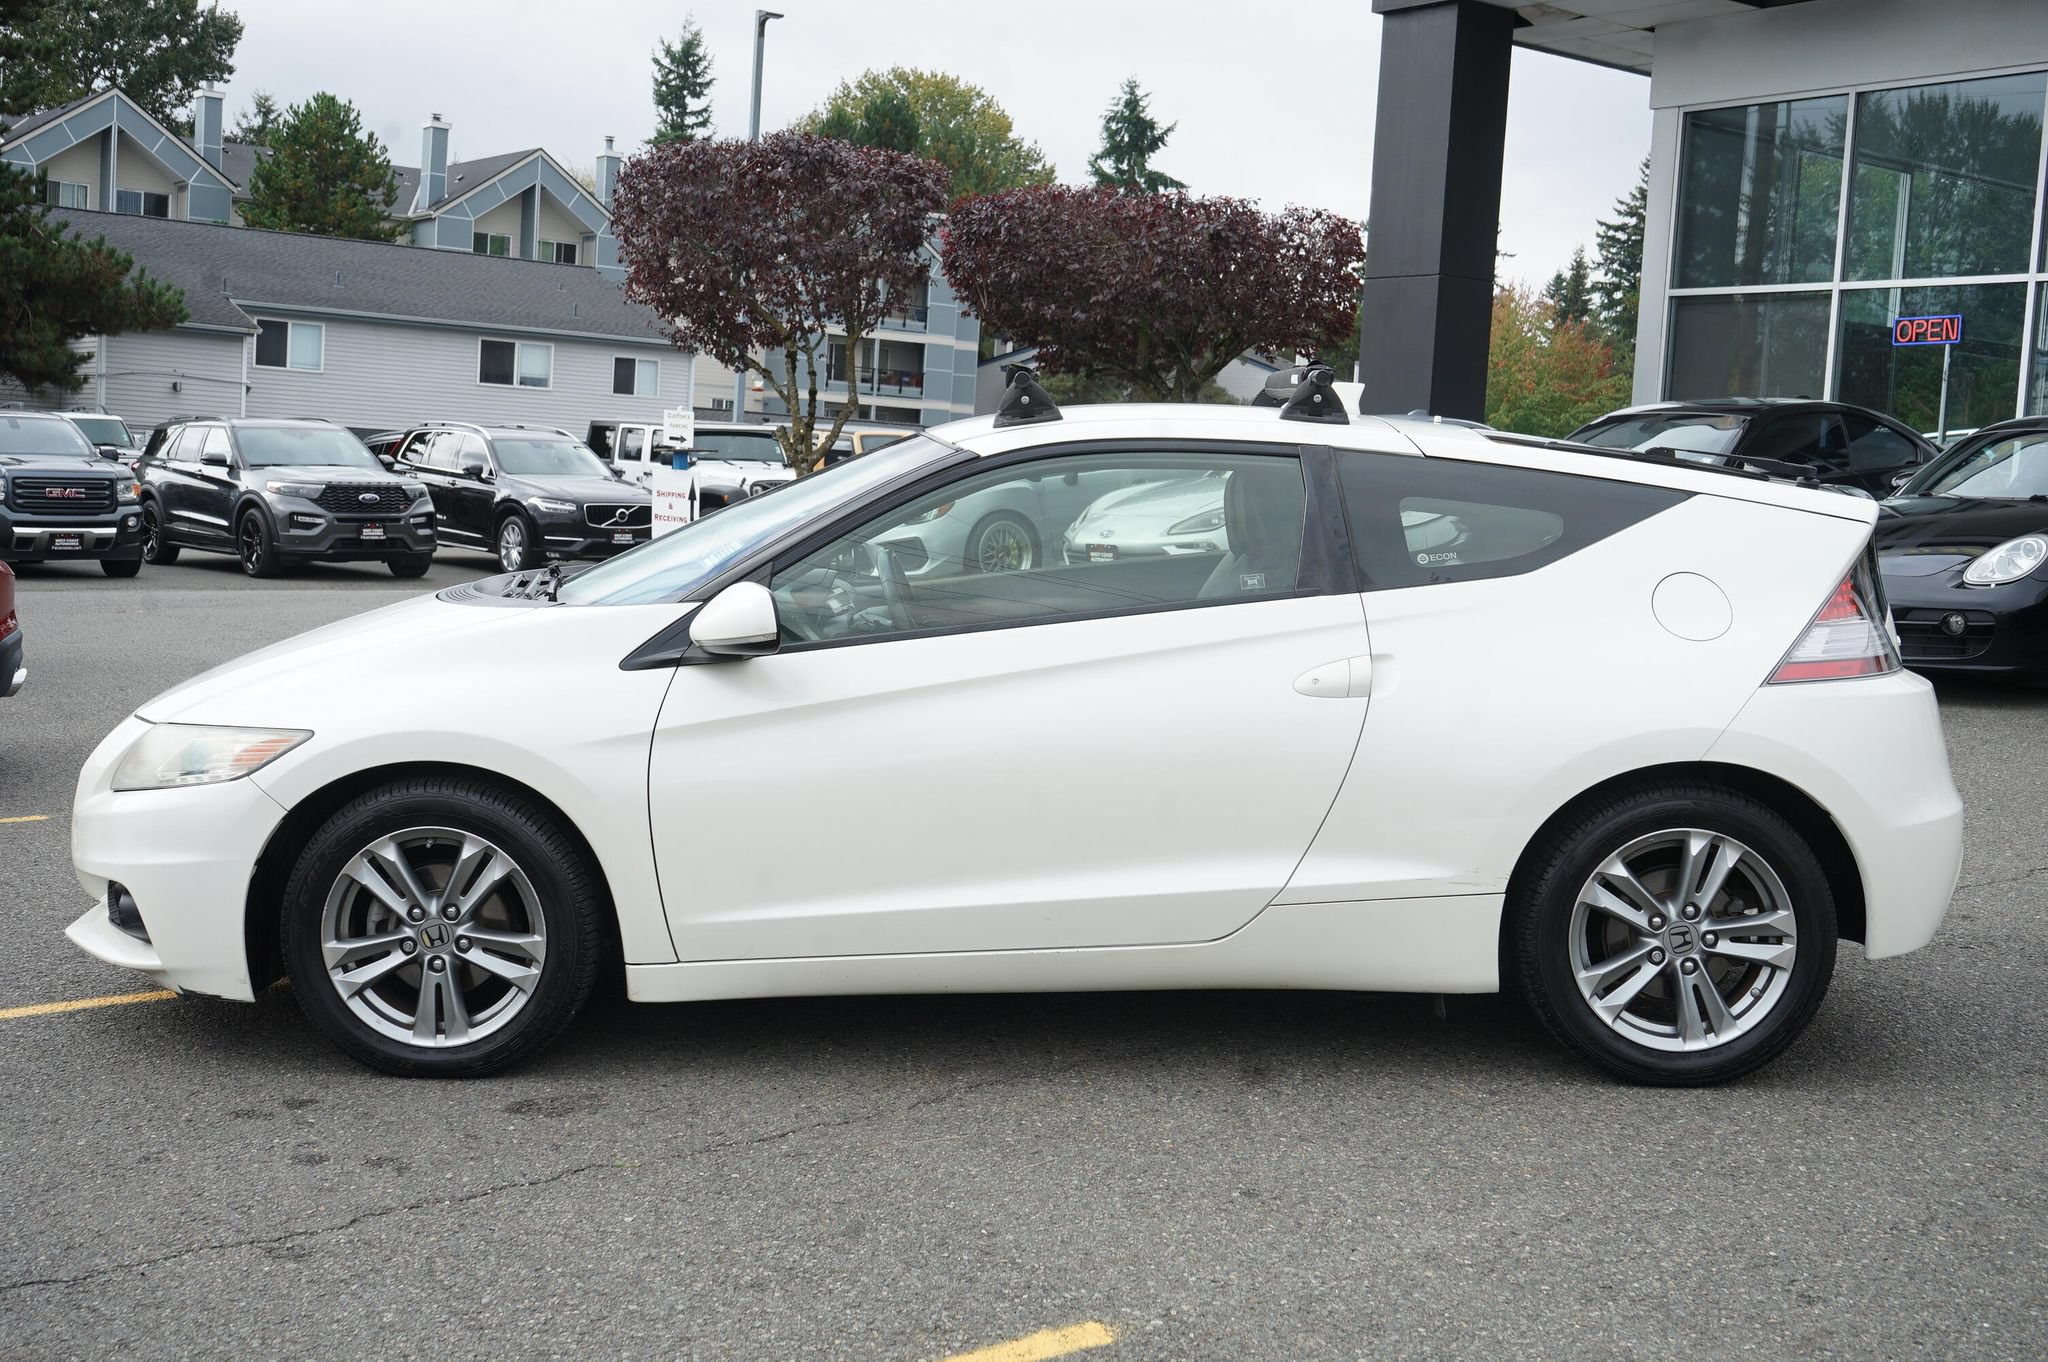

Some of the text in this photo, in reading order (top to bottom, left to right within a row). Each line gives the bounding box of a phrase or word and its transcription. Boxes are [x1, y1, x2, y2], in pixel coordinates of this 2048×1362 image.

[1896, 318, 1958, 342] OPEN
[45, 487, 86, 498] GMC
[656, 489, 686, 499] SHIPPING
[668, 502, 673, 510] &
[654, 513, 688, 524] RECEIVING
[1430, 552, 1457, 561] ECON
